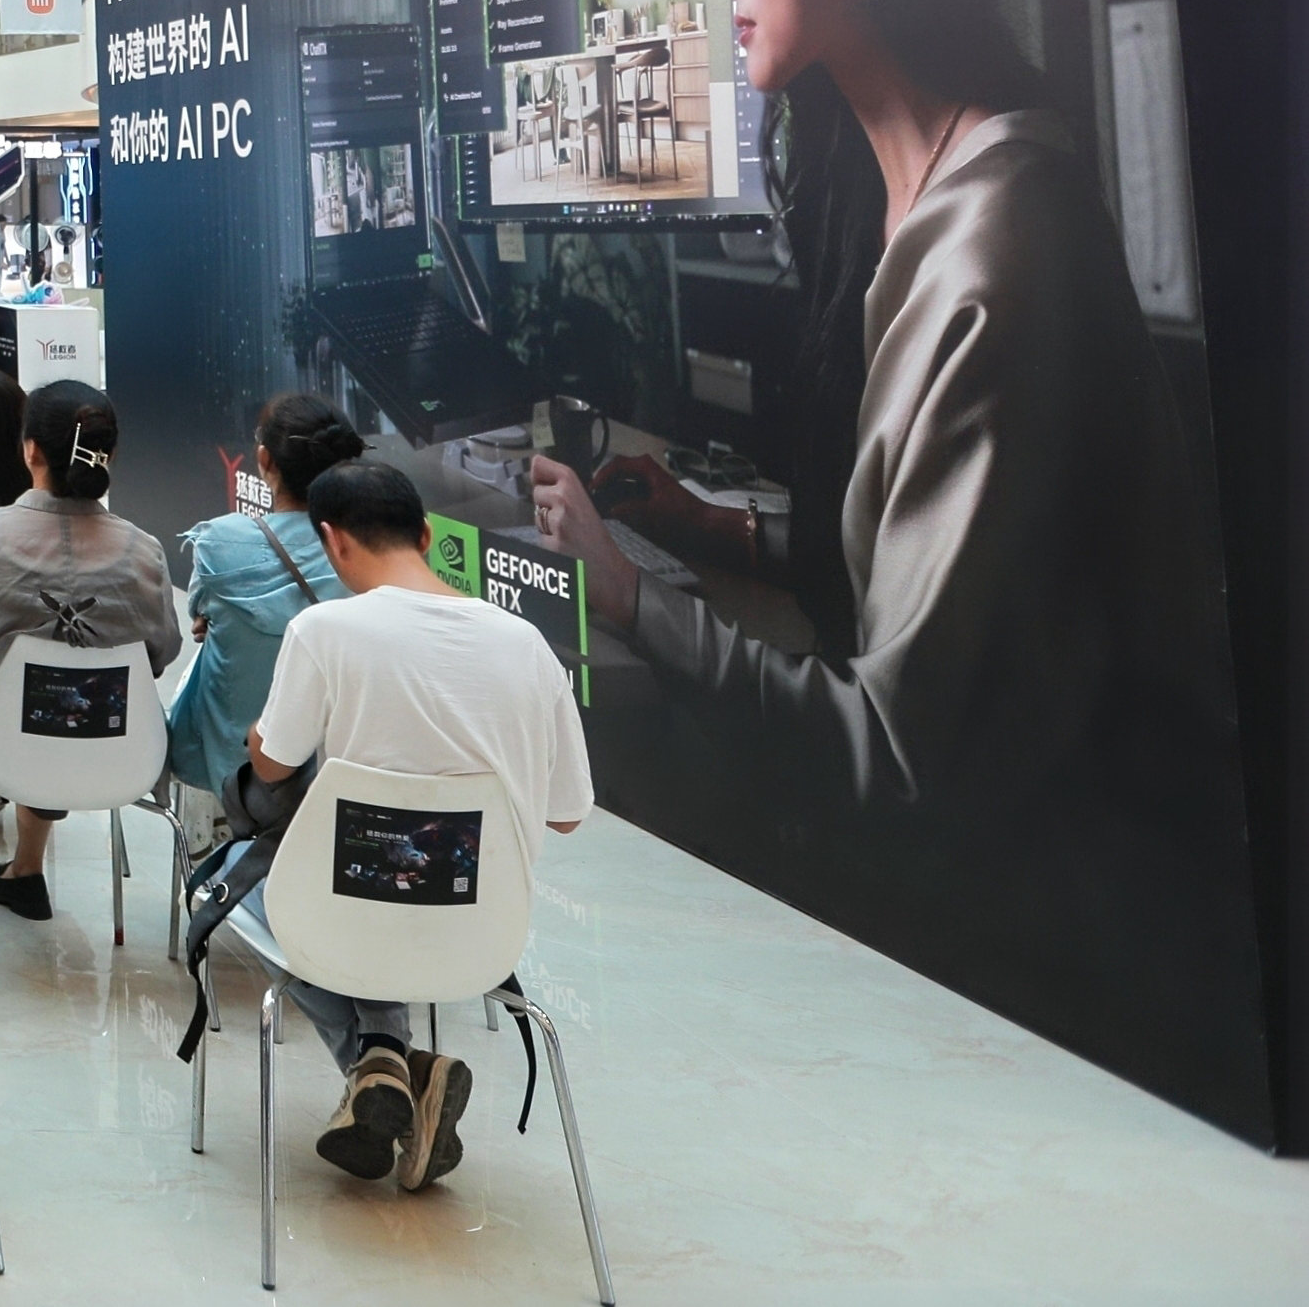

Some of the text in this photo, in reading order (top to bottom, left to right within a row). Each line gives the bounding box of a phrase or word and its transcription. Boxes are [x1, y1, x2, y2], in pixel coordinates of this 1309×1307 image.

[107, 3, 250, 86] 构建世界的 AI
[110, 98, 254, 166] 和你的 AI PC
[49, 344, 77, 354] 拯救者
[235, 470, 273, 509] 拯救者
[485, 546, 570, 600] GEFORCE
[487, 577, 523, 615] RTX
